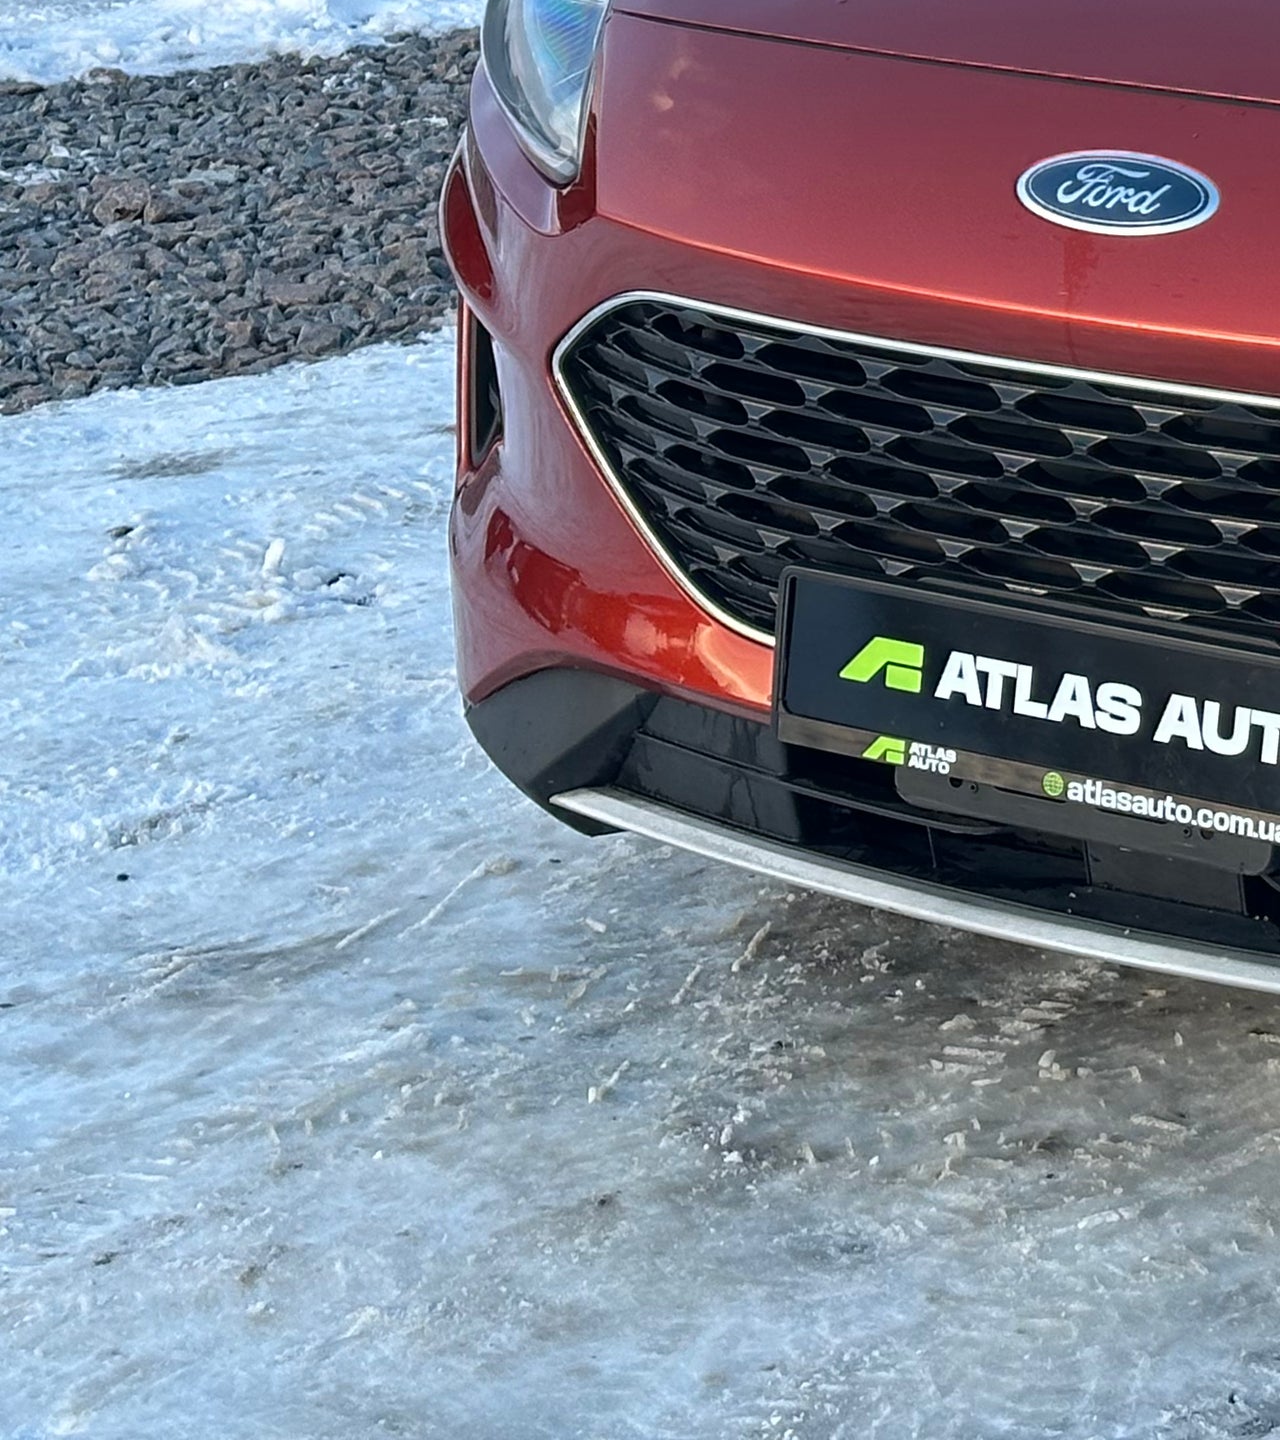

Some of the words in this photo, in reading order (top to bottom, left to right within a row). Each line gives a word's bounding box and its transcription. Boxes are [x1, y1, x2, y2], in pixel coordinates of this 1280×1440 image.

[1056, 163, 1171, 214] Ford
[934, 650, 1141, 736] ATLAS
[907, 757, 951, 775] AUTO
[908, 742, 957, 764] ATLAS
